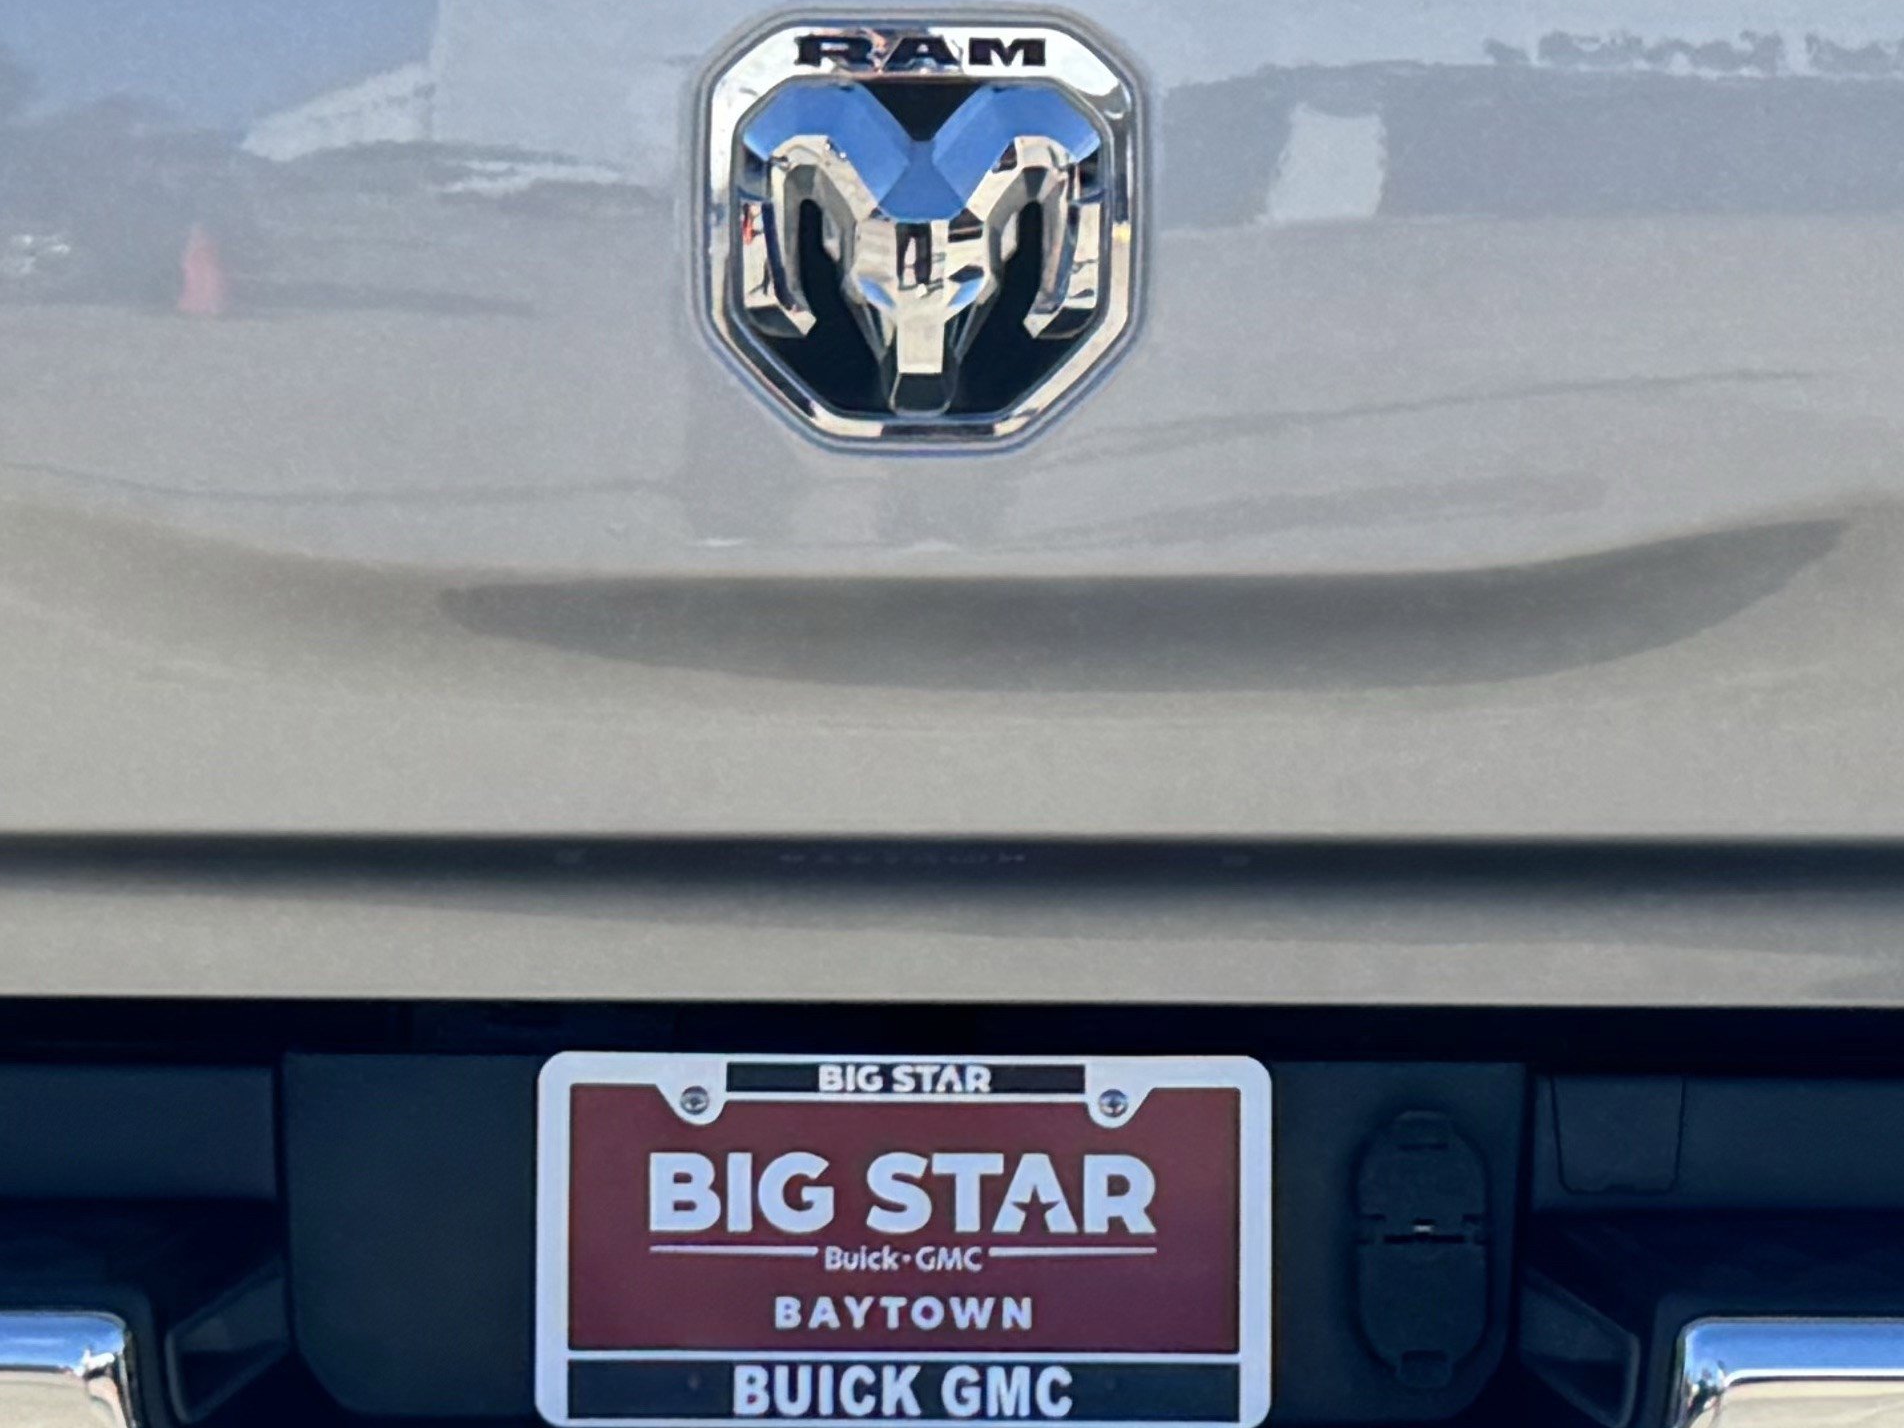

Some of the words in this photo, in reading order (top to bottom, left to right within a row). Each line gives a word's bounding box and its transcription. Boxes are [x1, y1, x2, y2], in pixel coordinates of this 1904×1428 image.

[795, 36, 1047, 72] RAM
[817, 1065, 883, 1092] BIG
[892, 1066, 991, 1093] STAR
[648, 1151, 835, 1233] BIG
[865, 1152, 1157, 1234] STAR
[774, 1295, 1033, 1331] BAYTOWN
[732, 1365, 921, 1418] BUICK
[941, 1366, 1074, 1419] GMC
